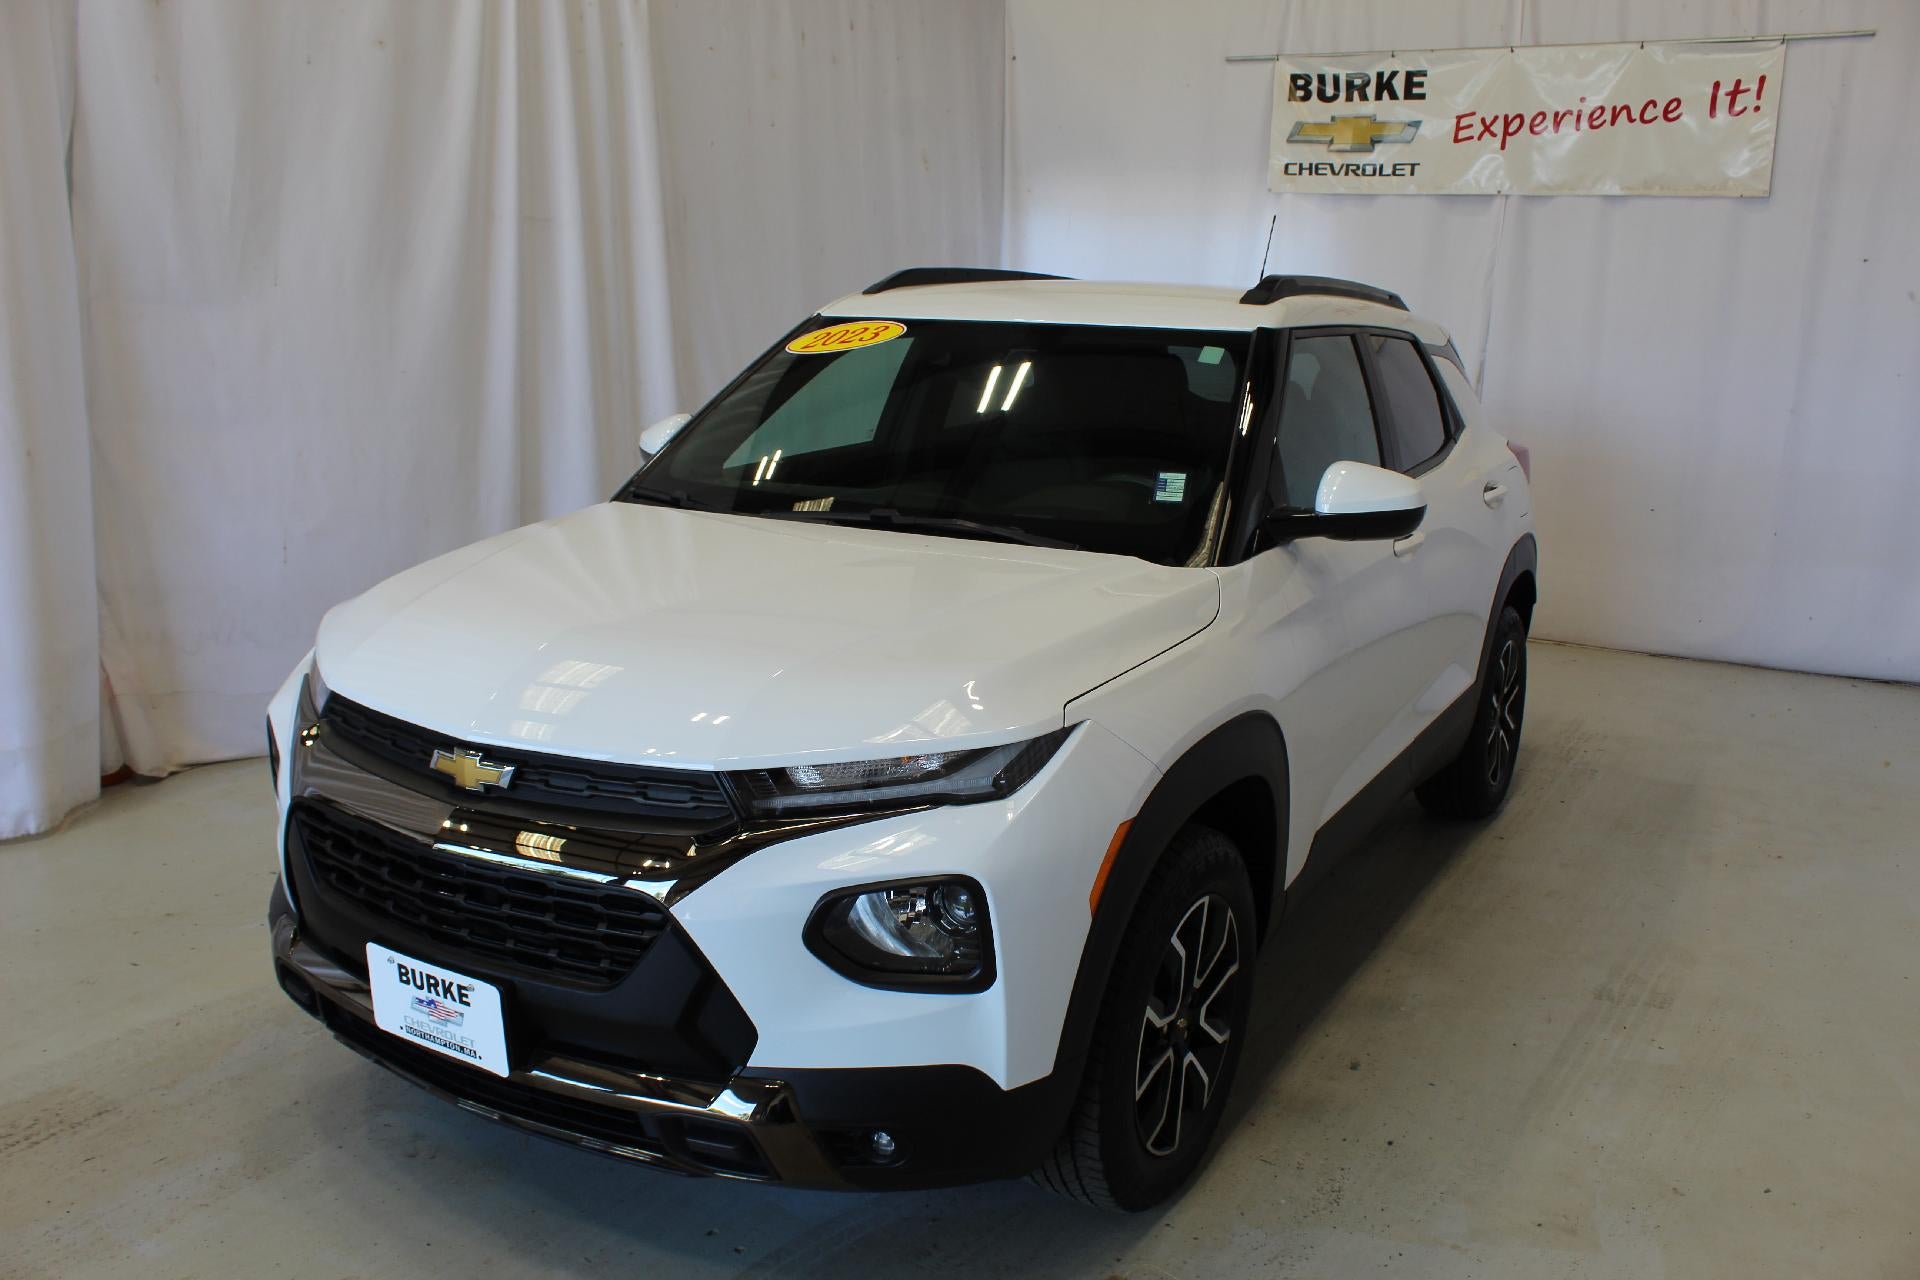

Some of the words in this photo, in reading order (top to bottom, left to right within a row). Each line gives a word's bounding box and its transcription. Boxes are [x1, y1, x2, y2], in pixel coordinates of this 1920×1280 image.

[1288, 69, 1428, 103] BURKE
[1452, 96, 1683, 150] Experience
[1709, 74, 1767, 119] It!
[1283, 161, 1421, 177] CHEVROLET
[800, 325, 890, 349] 2023
[397, 963, 471, 1007] BURKE
[404, 1015, 476, 1047] CHEVROLET
